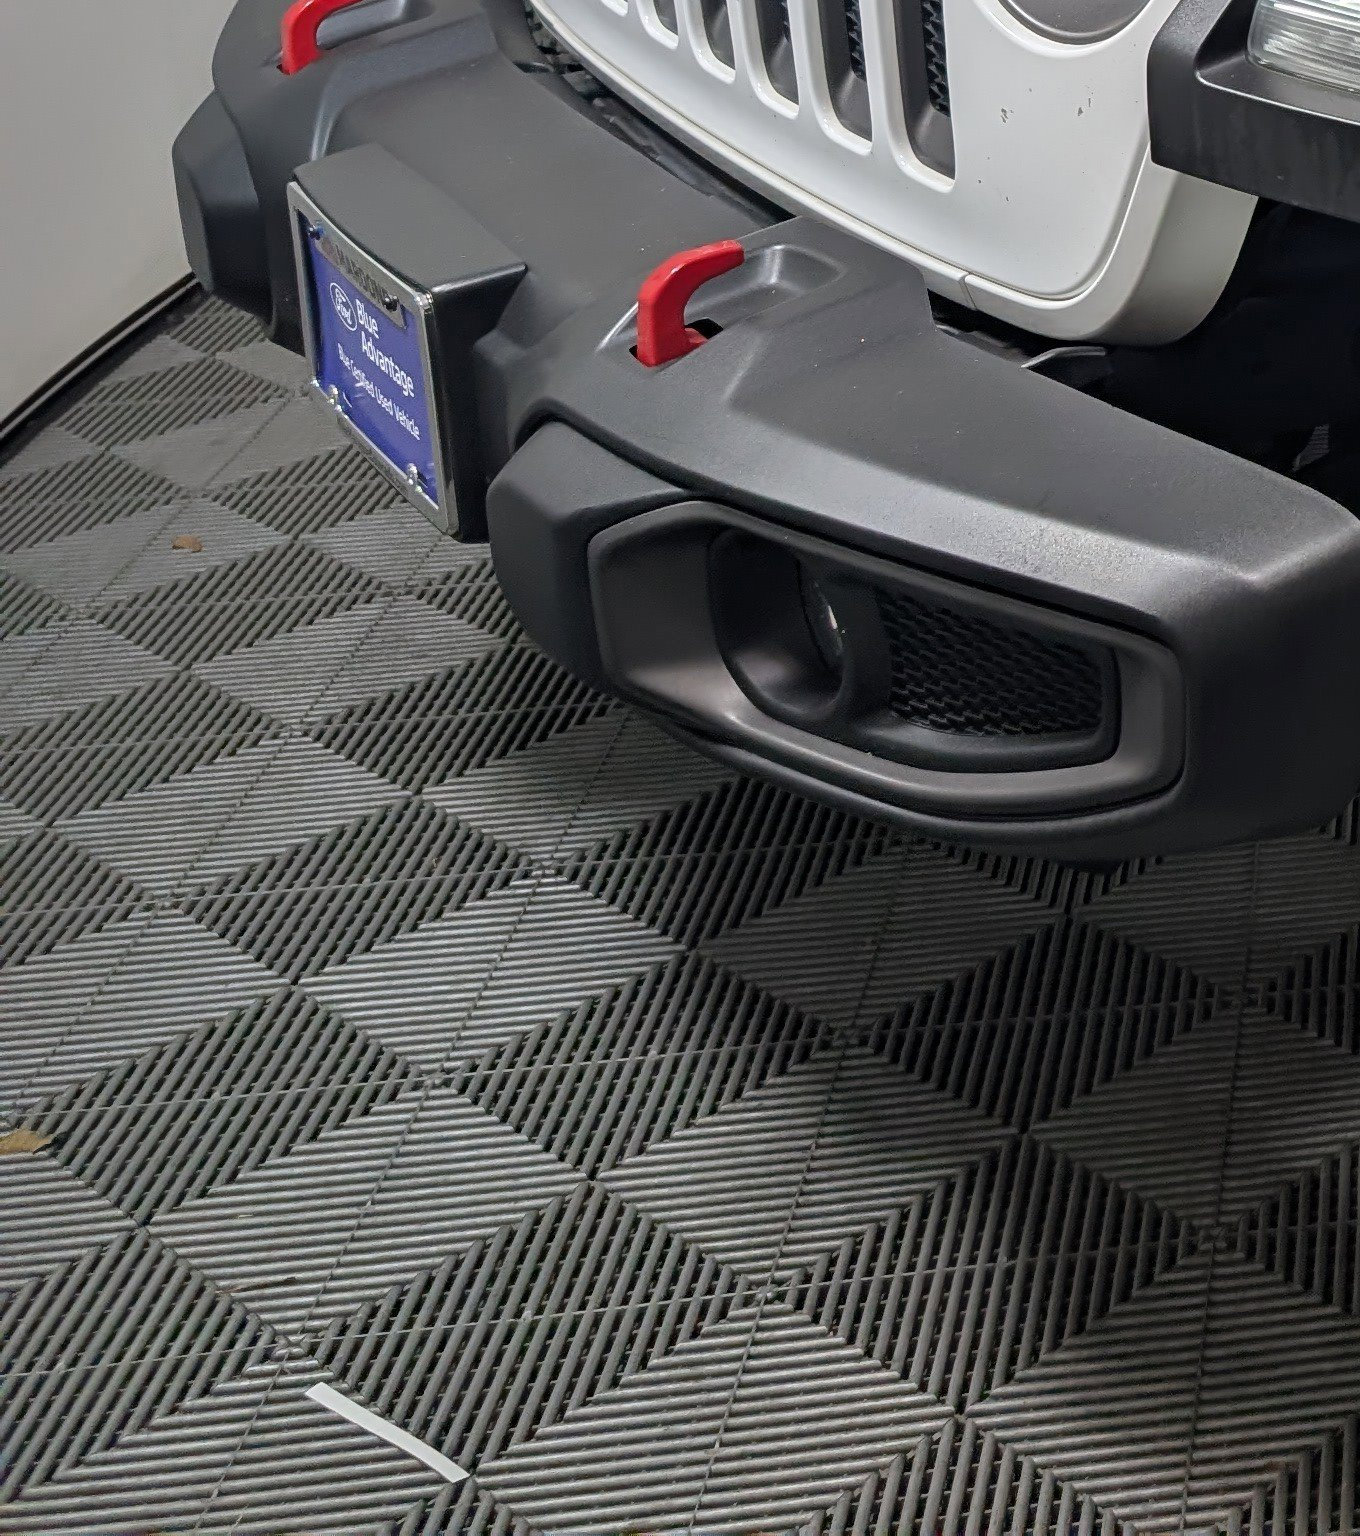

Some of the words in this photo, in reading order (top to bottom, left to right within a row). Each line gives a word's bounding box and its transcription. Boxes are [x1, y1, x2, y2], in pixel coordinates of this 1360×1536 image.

[355, 298, 379, 340] Blue
[361, 330, 415, 398] Advantage
[374, 385, 394, 416] Used
[393, 402, 421, 441] Vehicle
